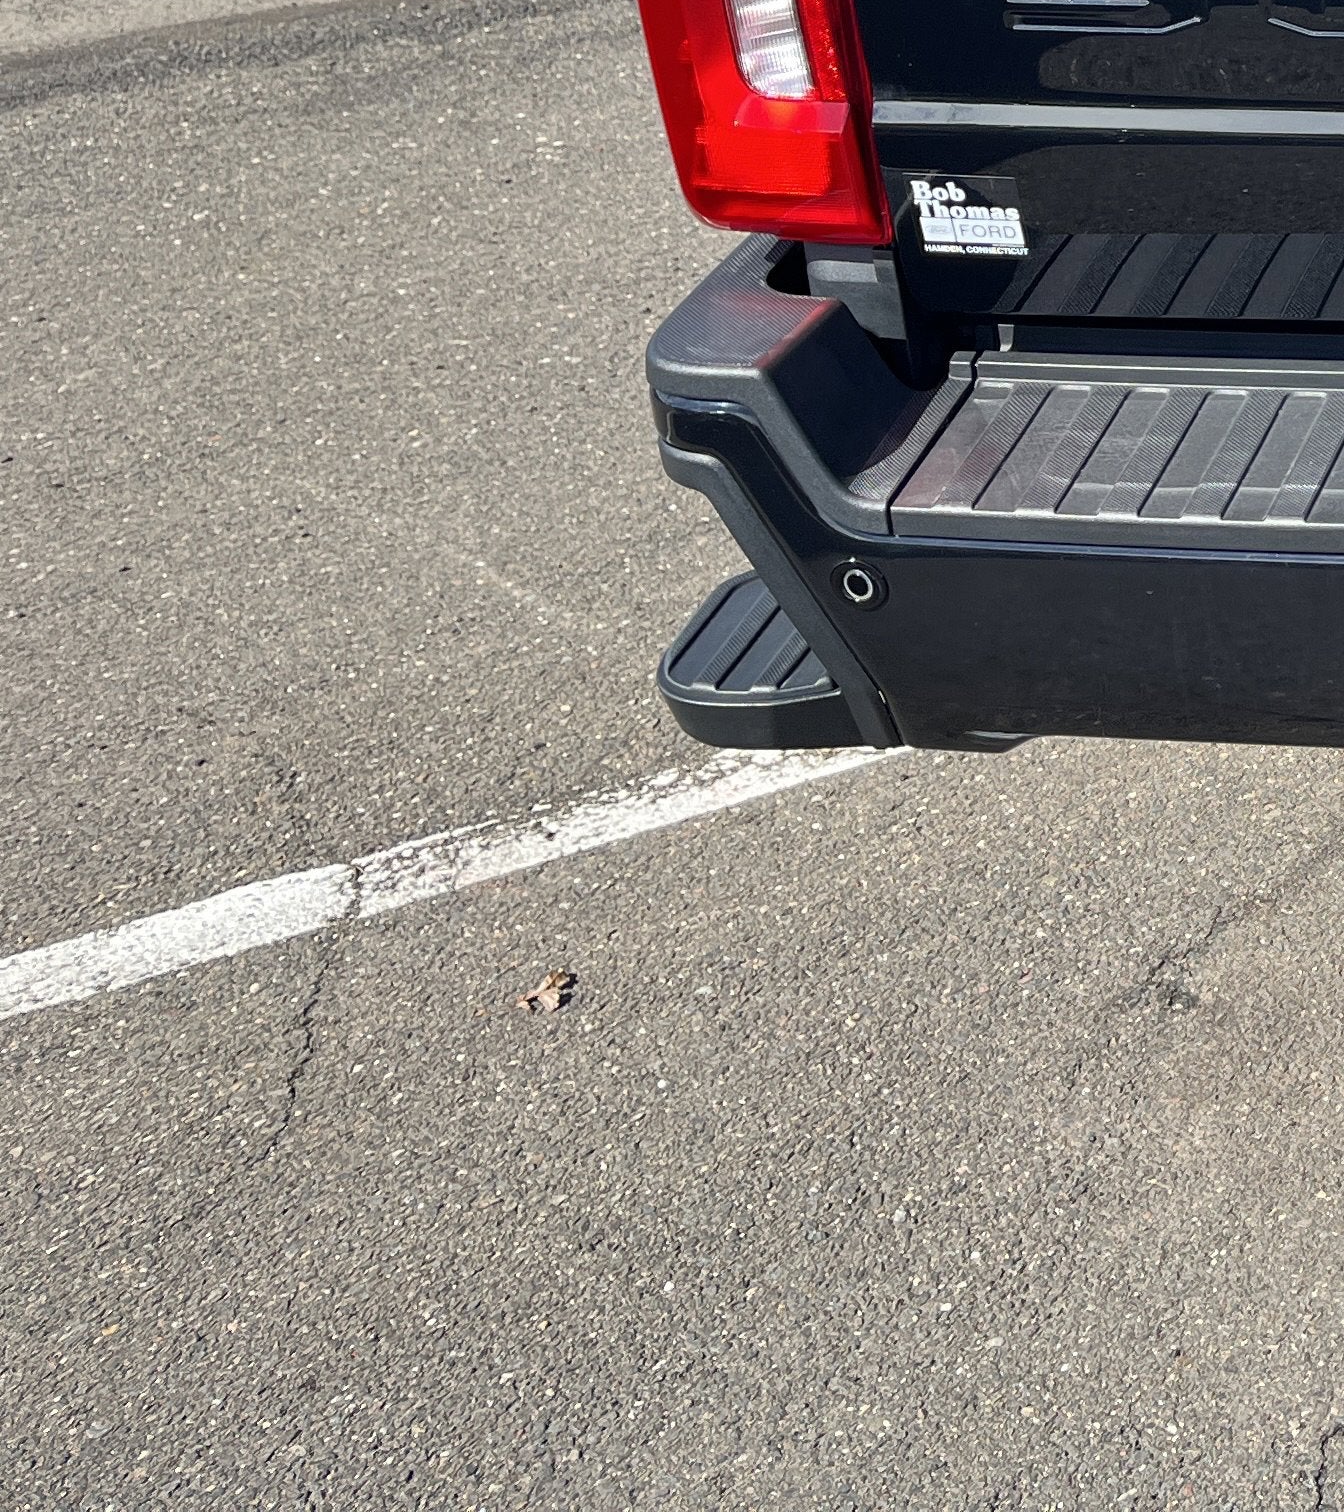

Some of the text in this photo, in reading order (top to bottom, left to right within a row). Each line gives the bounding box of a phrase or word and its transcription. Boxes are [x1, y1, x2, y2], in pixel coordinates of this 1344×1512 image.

[910, 180, 966, 202] Bob
[914, 199, 1020, 221] Thomas
[959, 224, 1016, 238] FORD
[966, 245, 1029, 255] CONNECTICUT
